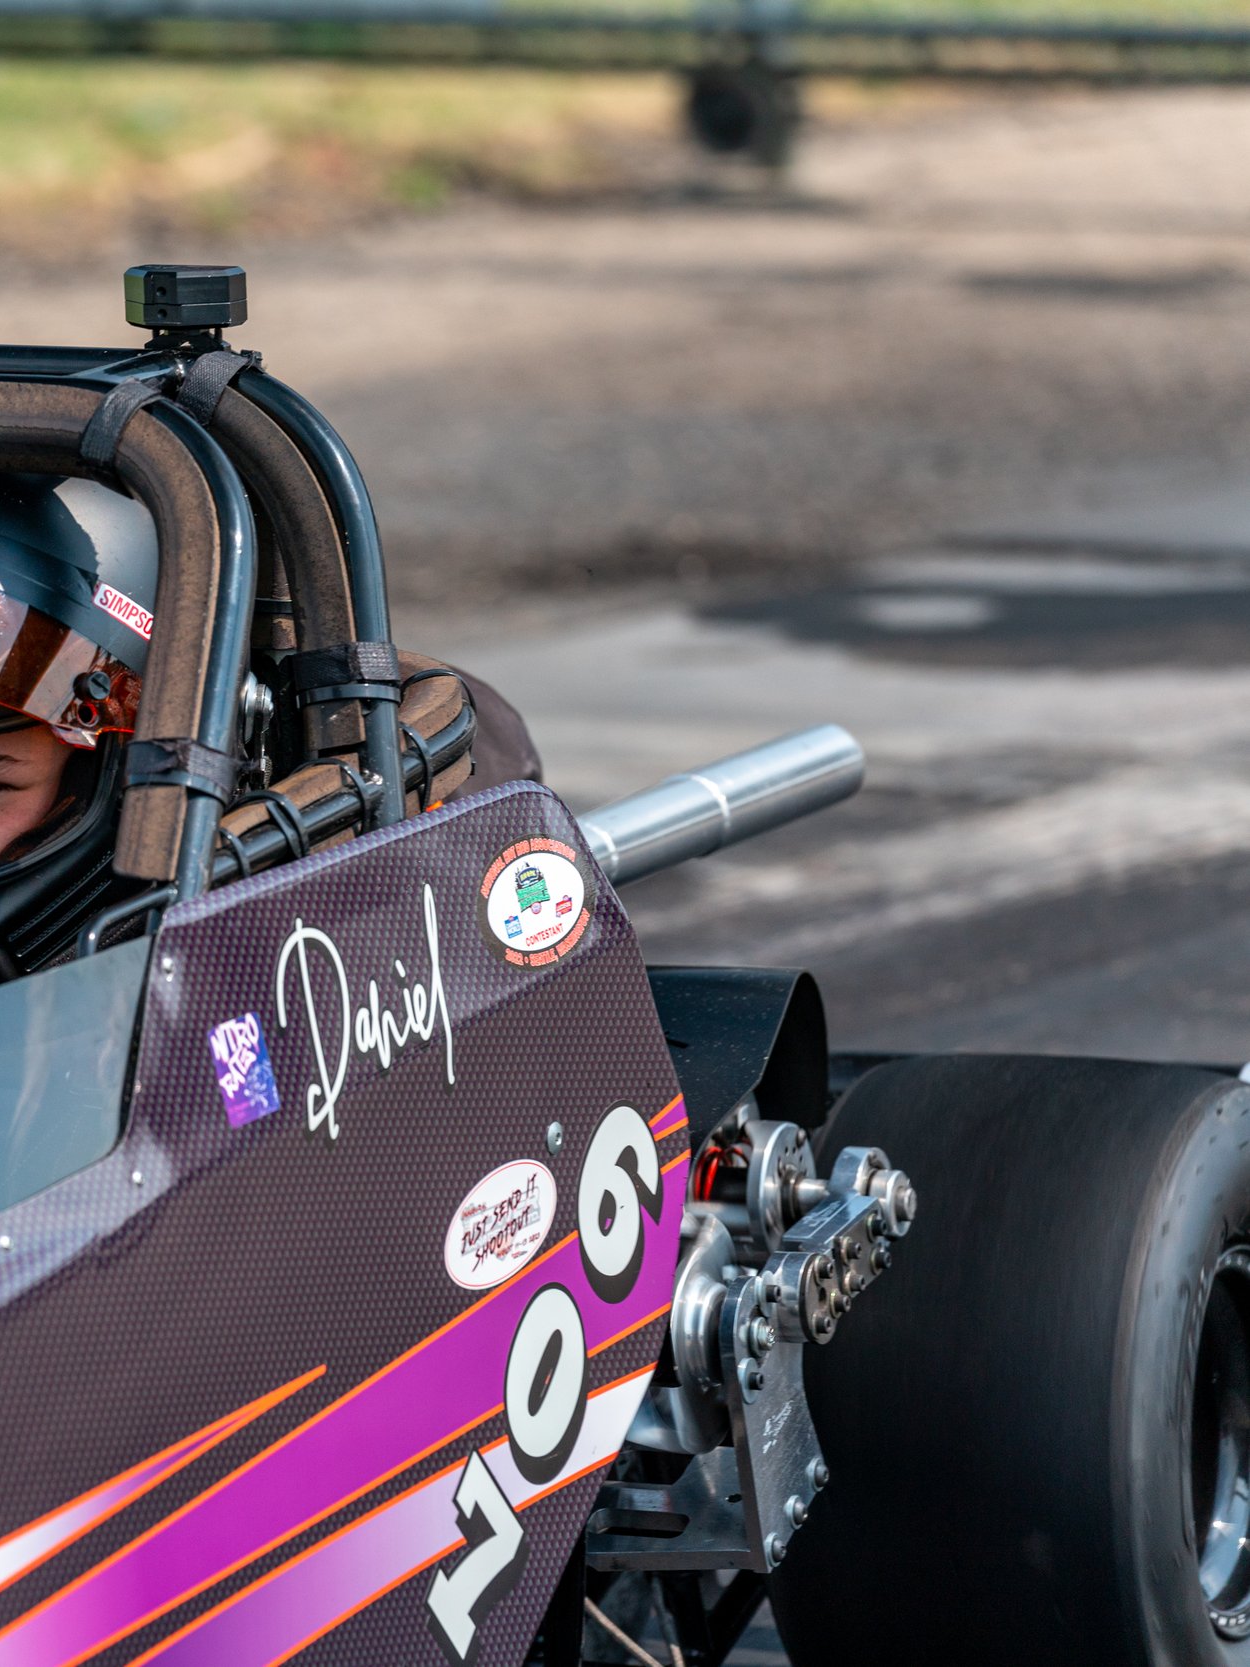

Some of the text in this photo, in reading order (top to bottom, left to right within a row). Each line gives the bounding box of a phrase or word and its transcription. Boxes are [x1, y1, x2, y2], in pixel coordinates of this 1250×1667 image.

[525, 923, 563, 947] CONTESTANT
[210, 1012, 261, 1064] NITRO
[276, 884, 455, 1140] Daniel
[461, 1216, 488, 1255] JUST
[490, 1188, 522, 1231] SEND
[526, 1172, 538, 1199] IT
[472, 1205, 531, 1272] SHOOTOUT
